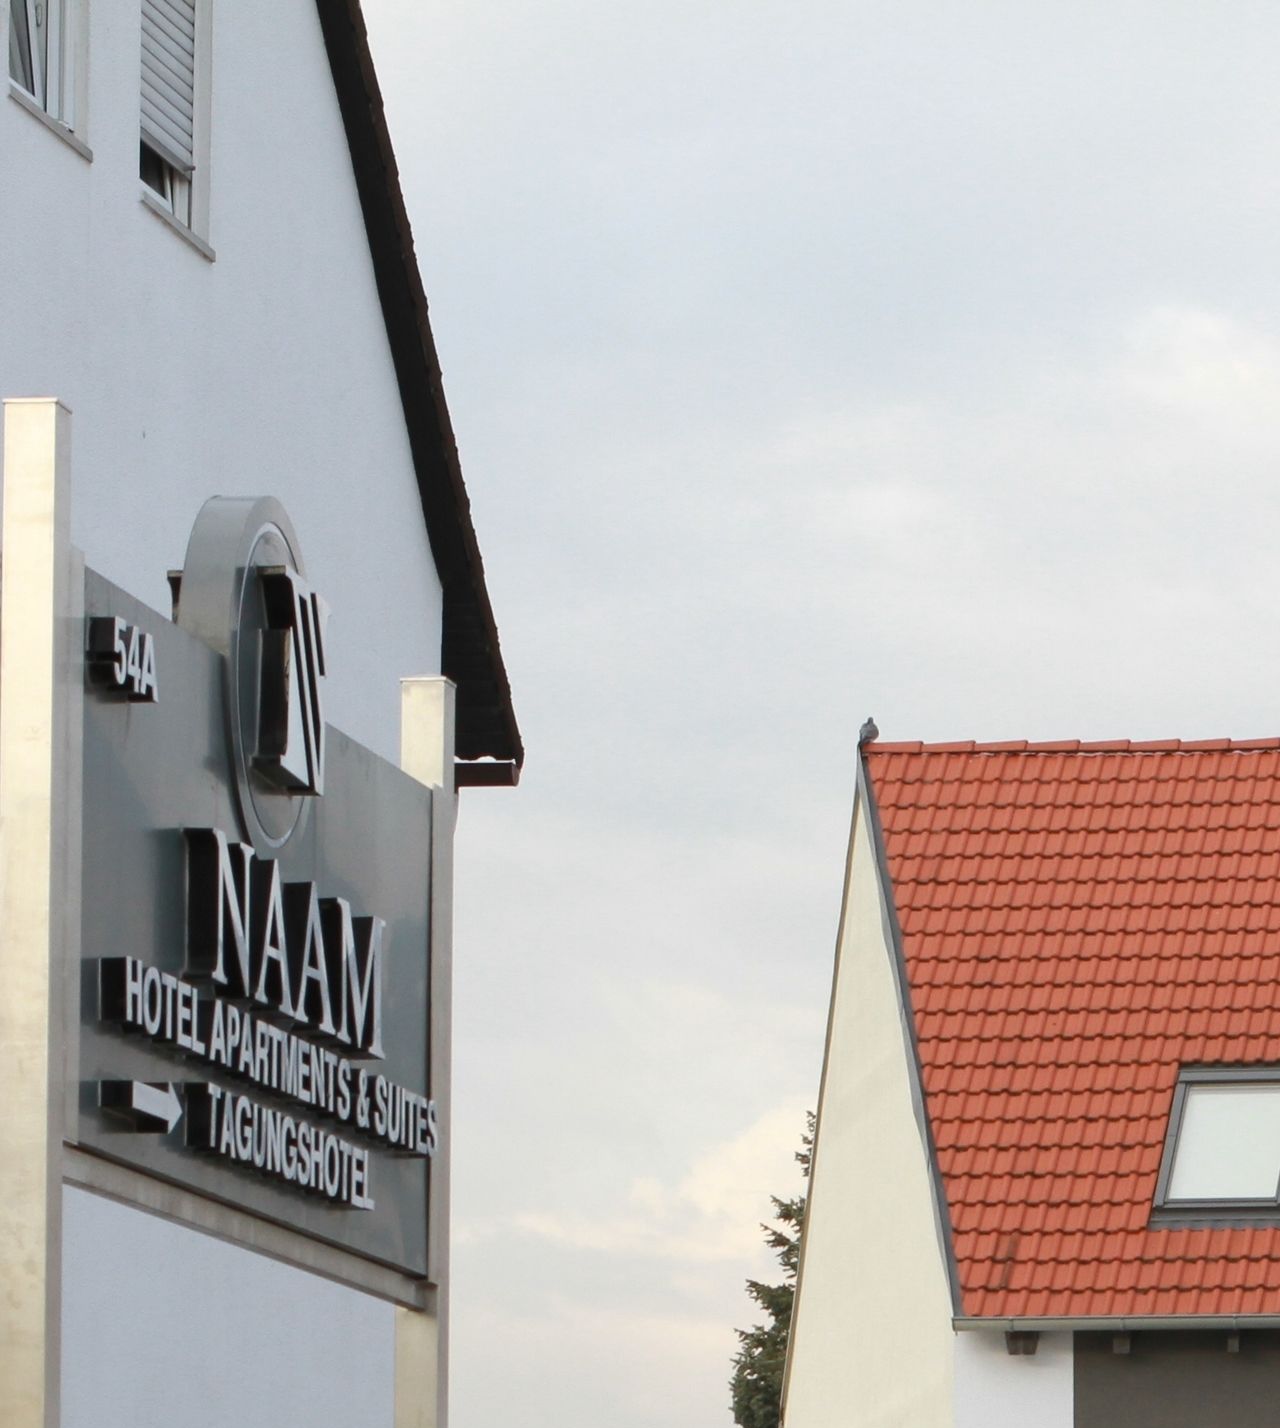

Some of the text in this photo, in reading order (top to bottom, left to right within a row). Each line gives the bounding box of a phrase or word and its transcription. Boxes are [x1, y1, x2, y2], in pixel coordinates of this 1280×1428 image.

[113, 615, 159, 704] 54A
[211, 827, 387, 1060] NAAM
[125, 954, 439, 1155] HOTEL APARTMENTS & SUITES
[207, 1080, 376, 1211] TAGUNGSHOTEL
